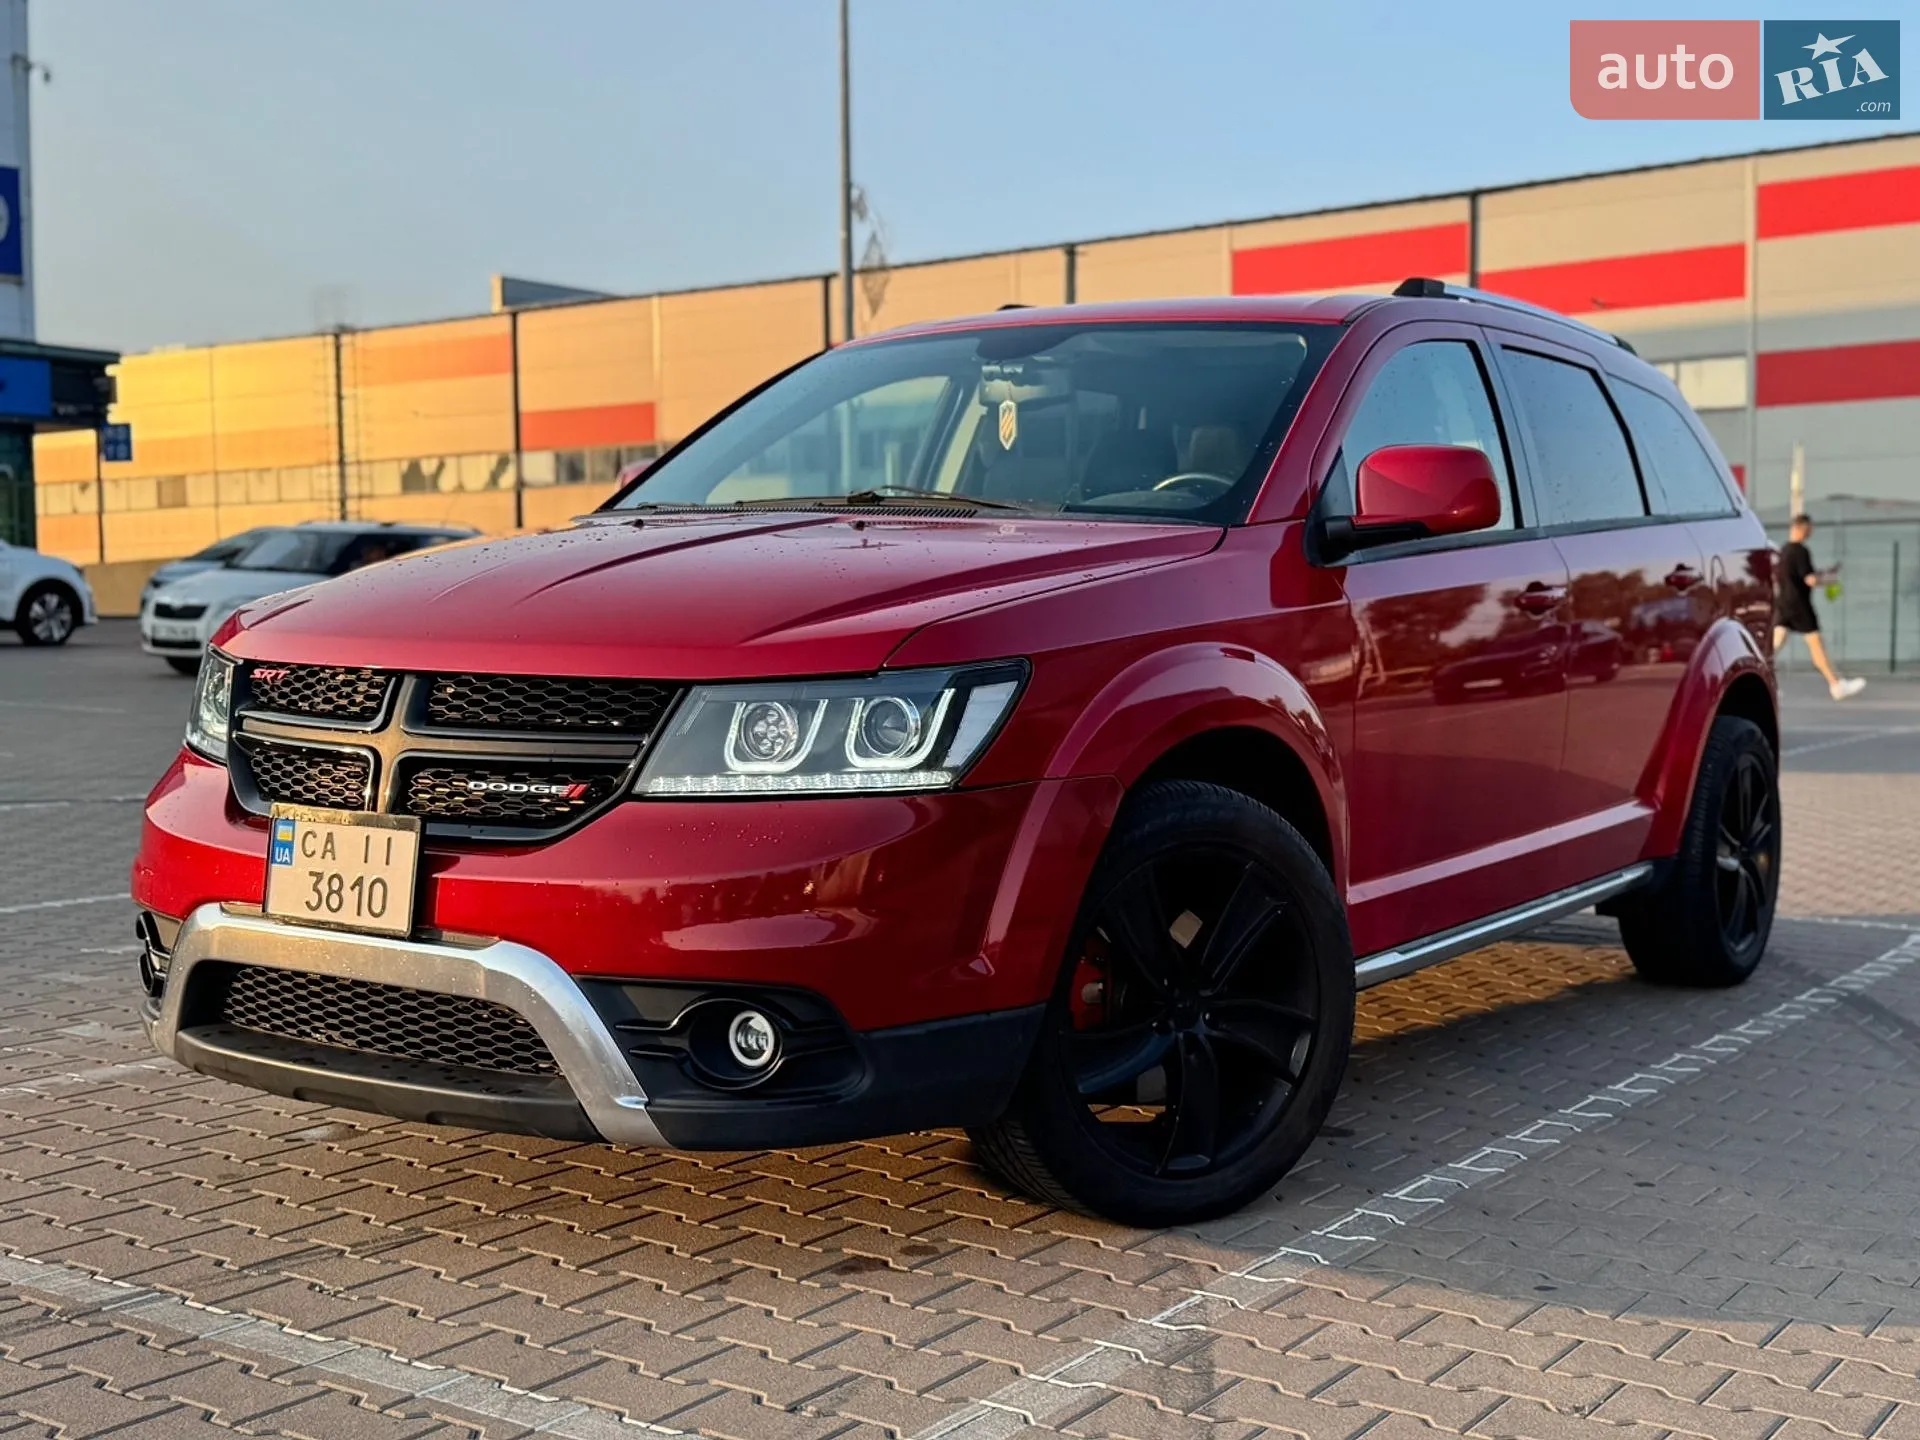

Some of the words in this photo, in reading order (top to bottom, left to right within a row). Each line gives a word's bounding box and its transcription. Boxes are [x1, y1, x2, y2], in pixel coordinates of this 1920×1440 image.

[250, 668, 290, 685] SRT
[468, 781, 570, 796] DODGE
[301, 830, 336, 861] CA
[275, 847, 291, 863] UA
[304, 871, 388, 918] 3810
